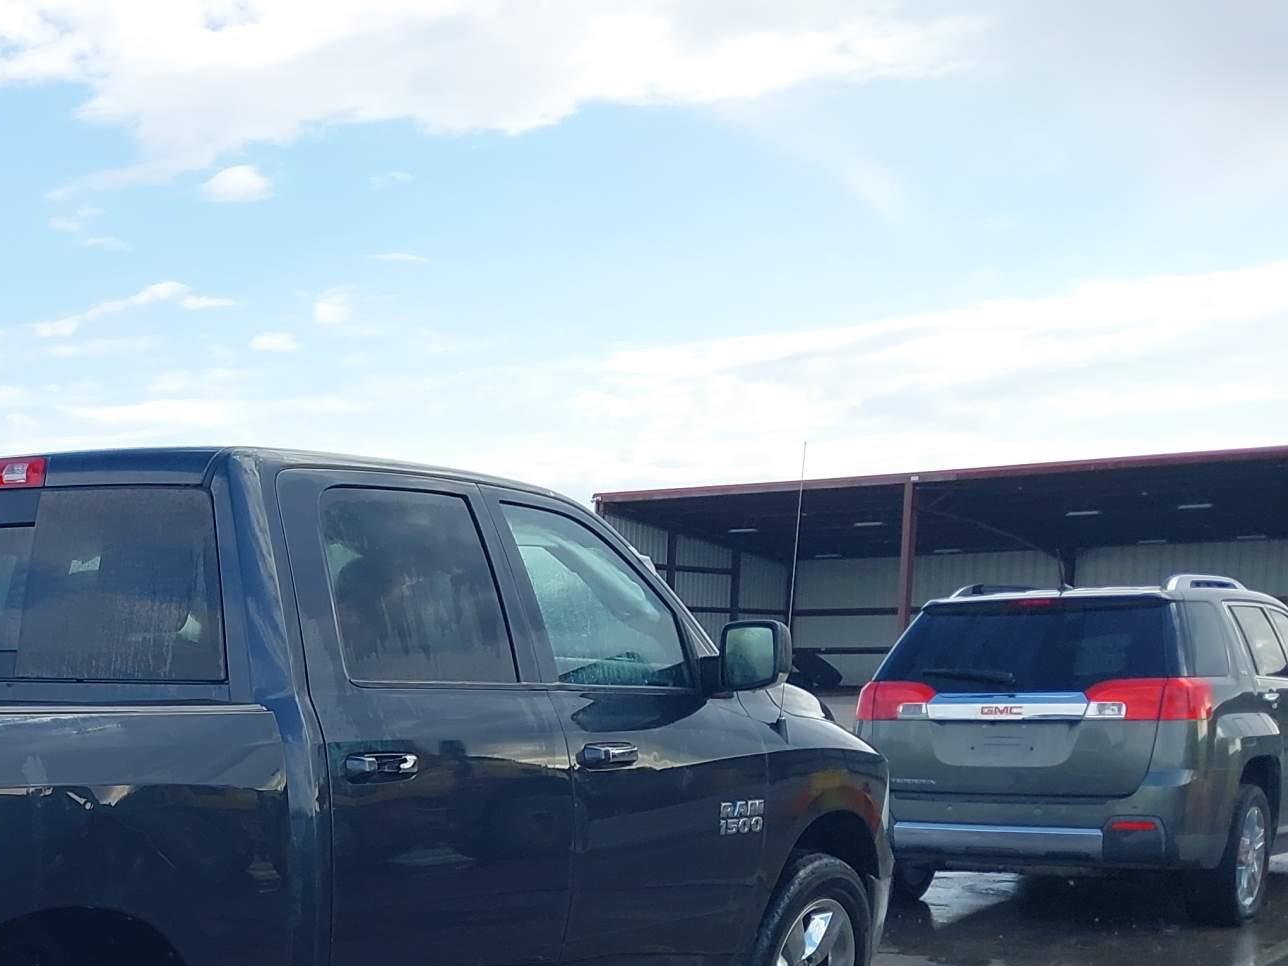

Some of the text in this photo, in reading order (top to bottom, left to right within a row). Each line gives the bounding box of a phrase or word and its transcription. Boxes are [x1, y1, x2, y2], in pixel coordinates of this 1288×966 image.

[980, 705, 1025, 716] GMC
[720, 799, 765, 818] RAM
[719, 816, 764, 836] 1500
